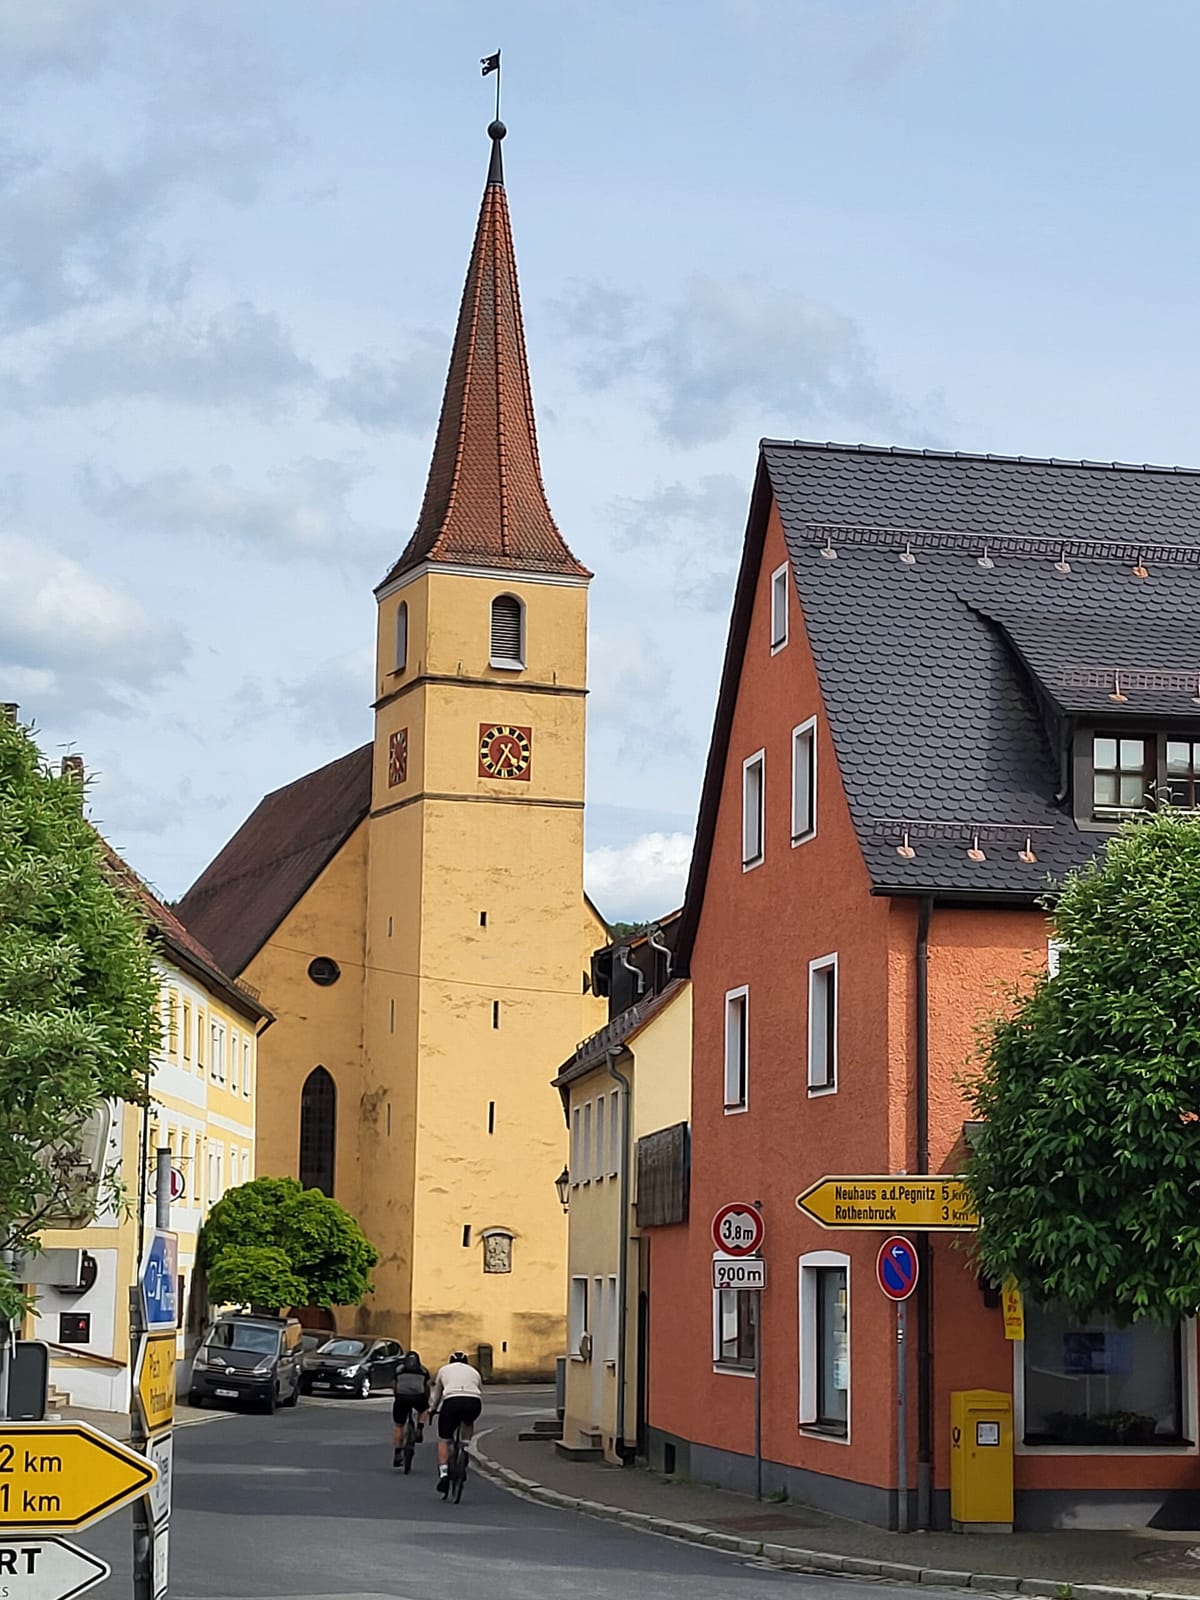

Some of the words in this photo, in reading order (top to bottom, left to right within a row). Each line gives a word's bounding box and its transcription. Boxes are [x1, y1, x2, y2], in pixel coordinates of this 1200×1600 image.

[835, 1186, 876, 1201] Neuhaus
[941, 1186, 949, 1200] 5
[835, 1205, 897, 1220] Rothenbruck
[941, 1205, 949, 1221] 3
[952, 1209, 969, 1221] km
[24, 1450, 62, 1473] km
[0, 1483, 10, 1512] 1
[23, 1490, 61, 1512] km
